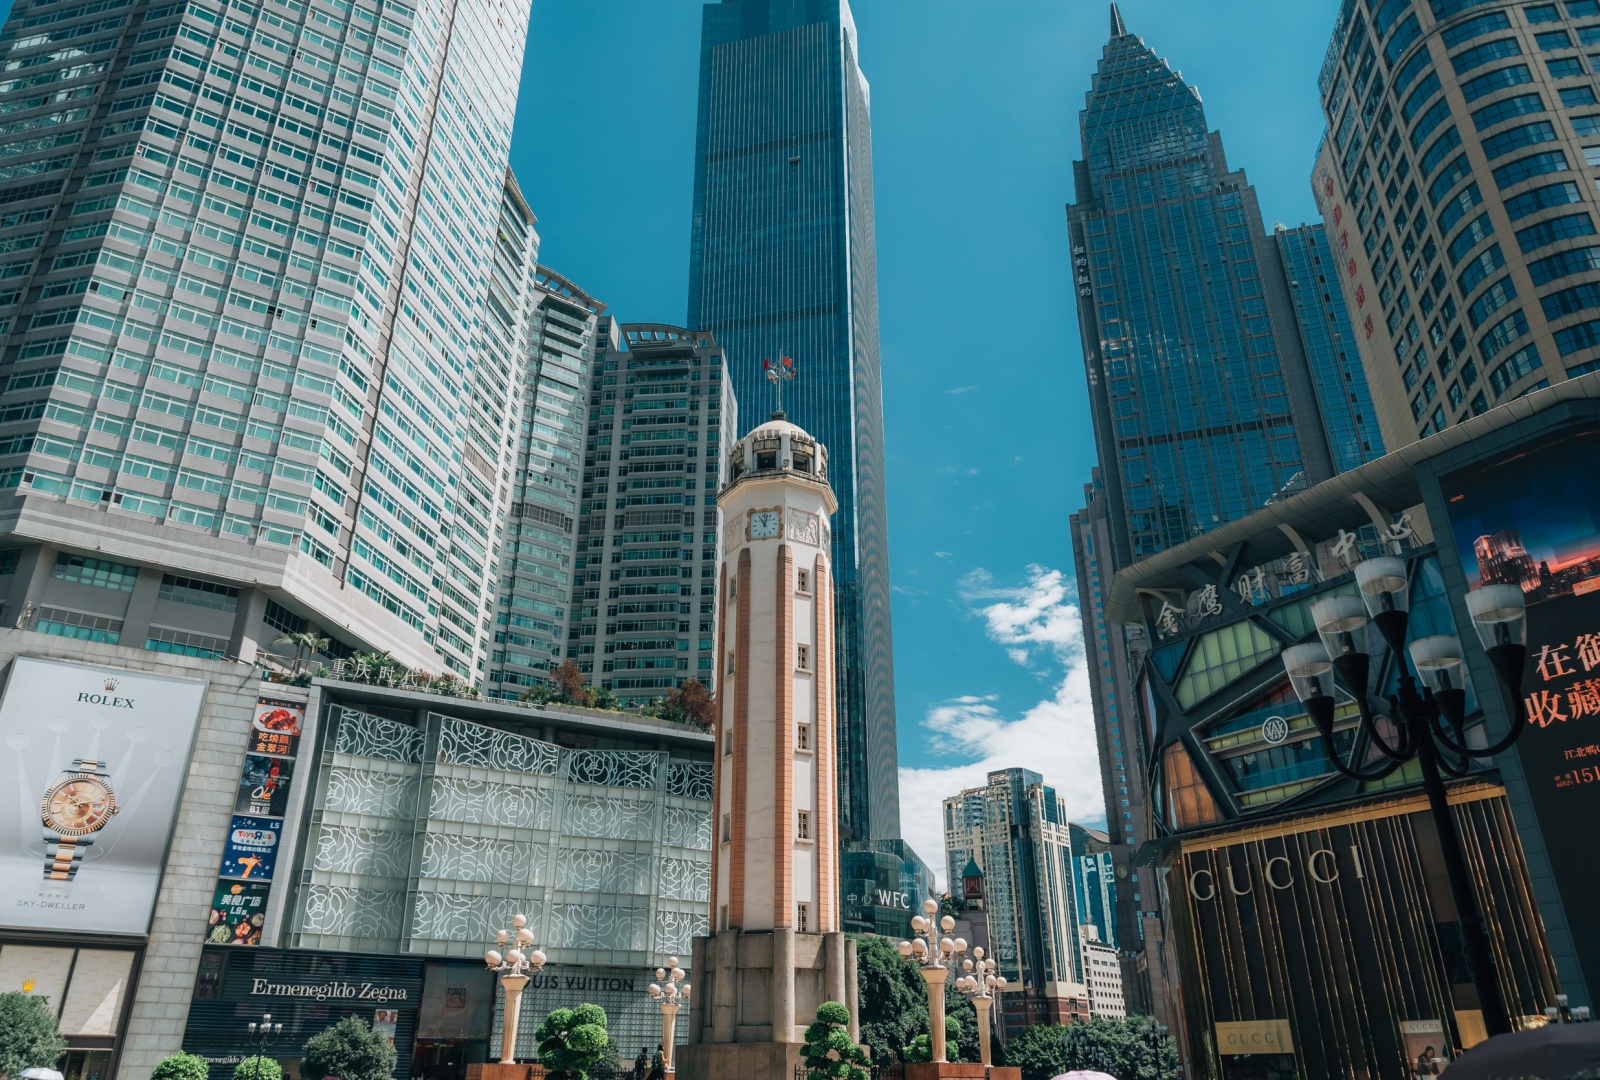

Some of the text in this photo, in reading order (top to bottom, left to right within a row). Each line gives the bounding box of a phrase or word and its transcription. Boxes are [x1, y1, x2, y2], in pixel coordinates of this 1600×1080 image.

[77, 692, 136, 709] ROLEX
[1524, 677, 1600, 728] 收藏
[1189, 845, 1365, 901] GUCCI
[16, 899, 86, 910] SKY-DWELLER
[220, 894, 262, 907] 美食广场
[878, 888, 910, 909] WFC
[250, 978, 408, 1003] Ermenegildo Zegna
[524, 975, 634, 991] UIS VUITTON
[1409, 1023, 1439, 1031] GUCCI
